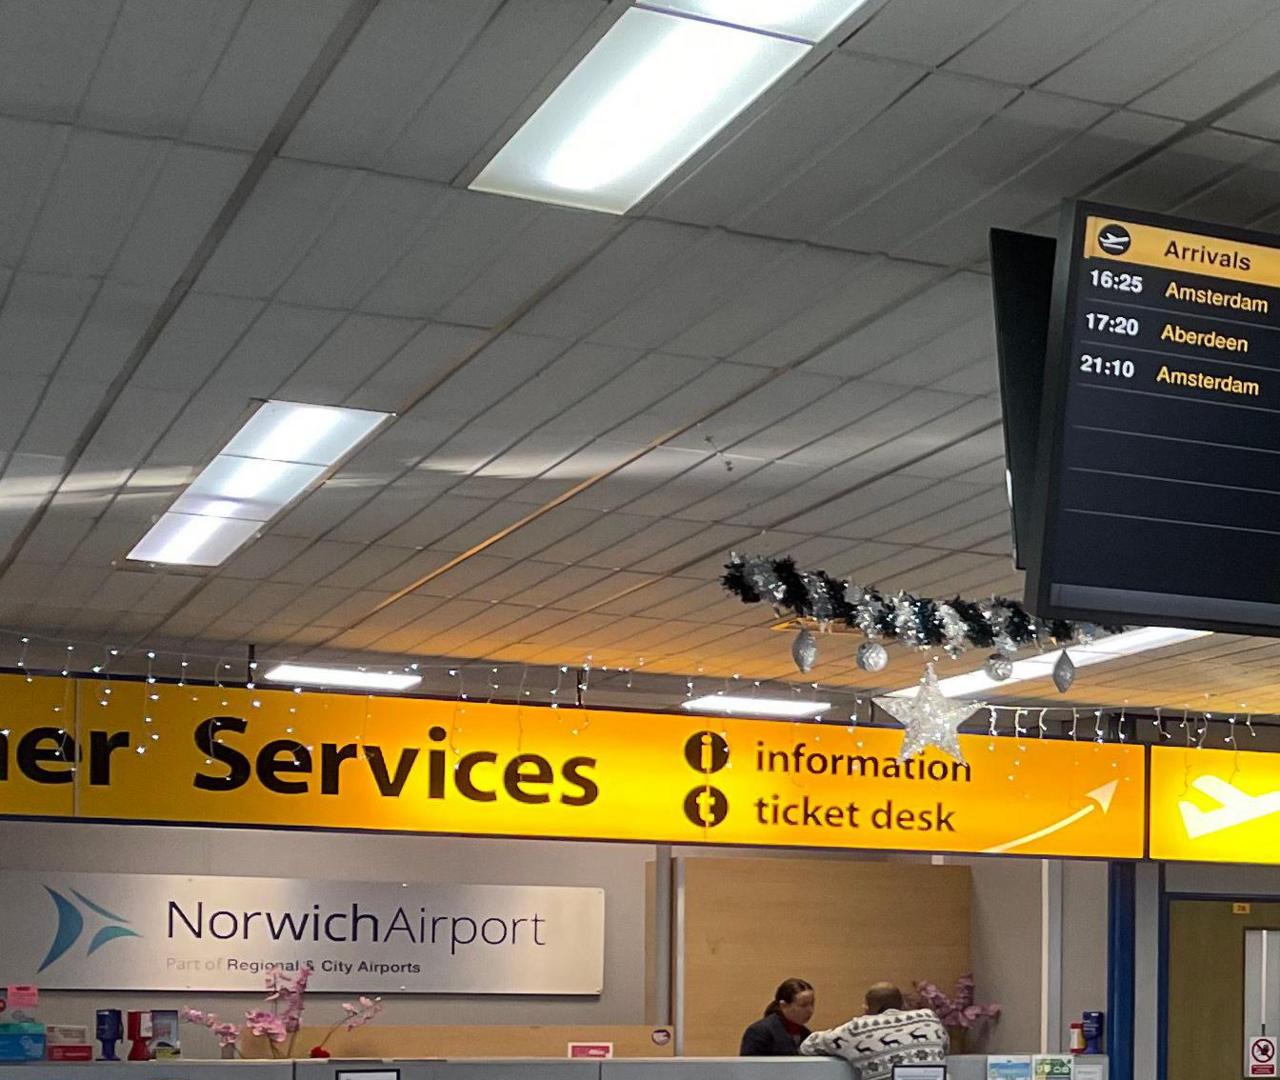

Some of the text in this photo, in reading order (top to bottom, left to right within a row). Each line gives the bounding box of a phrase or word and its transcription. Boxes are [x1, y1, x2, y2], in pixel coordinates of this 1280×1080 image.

[1164, 241, 1251, 271] Arrivals
[1090, 269, 1143, 293] 16:25
[1165, 282, 1269, 314] Amsterdam
[1086, 313, 1139, 336] 17:20
[1161, 324, 1249, 352] Aberdeen
[1080, 354, 1135, 378] 21:10
[1156, 366, 1260, 396] Amsterdam
[193, 716, 600, 807] Services
[756, 740, 972, 784] information
[754, 796, 958, 834] ticket desk
[167, 901, 547, 956] NorwichAirport
[166, 958, 200, 971] Part
[228, 958, 299, 975] Regional
[321, 960, 353, 976] City
[358, 961, 421, 976] Airports
